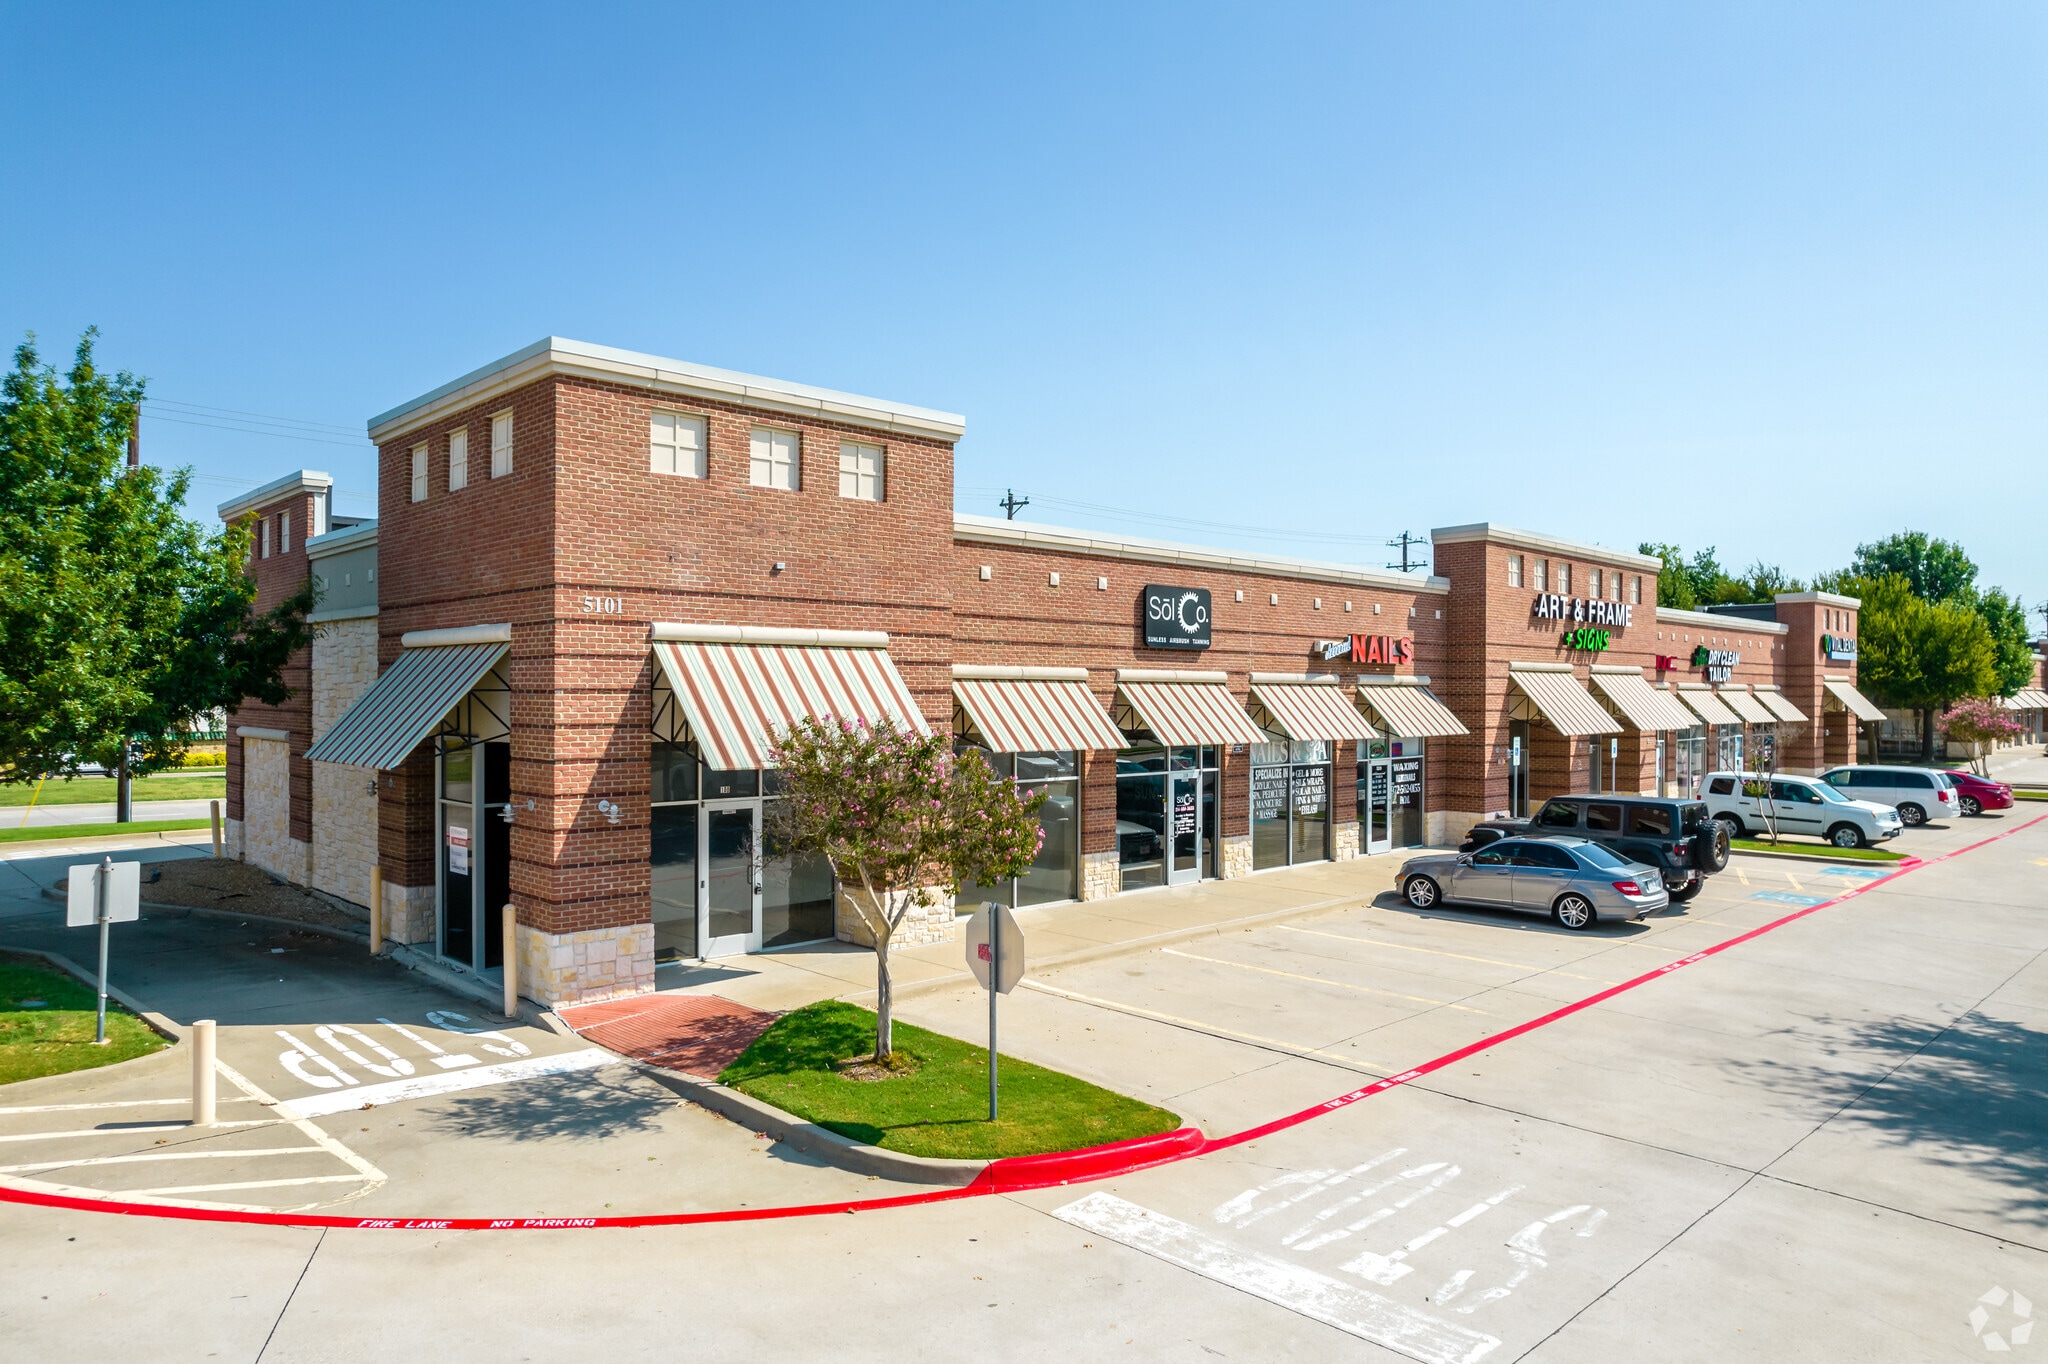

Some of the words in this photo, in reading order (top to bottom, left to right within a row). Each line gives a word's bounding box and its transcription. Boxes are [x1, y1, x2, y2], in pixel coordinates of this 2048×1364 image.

[583, 596, 623, 614] 5101
[1538, 593, 1568, 620] ART
[1574, 598, 1583, 622] &
[1588, 600, 1632, 627] FRAME
[1575, 627, 1610, 652] SIGNS
[1352, 633, 1413, 665] NAILS
[1708, 649, 1722, 665] DRY
[1721, 650, 1740, 666] CLEAN
[1709, 666, 1732, 682] TAILOR
[1295, 769, 1305, 777] GEL
[1310, 767, 1324, 776] MORE
[1393, 762, 1419, 771] WAXING
[1255, 768, 1282, 780] SPECIALIZE
[1272, 780, 1287, 789] NAILS
[1295, 778, 1306, 787] SILK
[1307, 777, 1324, 786] WRAPS
[1262, 789, 1286, 799] PEDICURE
[1295, 787, 1311, 796] SOLAR
[1311, 786, 1325, 794] NAILS
[1256, 798, 1282, 809] MANICURE
[274, 1010, 532, 1088] STOP
[358, 1218, 399, 1228] FIRE
[404, 1219, 452, 1229] LANE
[489, 1220, 514, 1228] NO
[523, 1218, 596, 1228] PARKING
[1212, 1147, 1608, 1314] STOP
